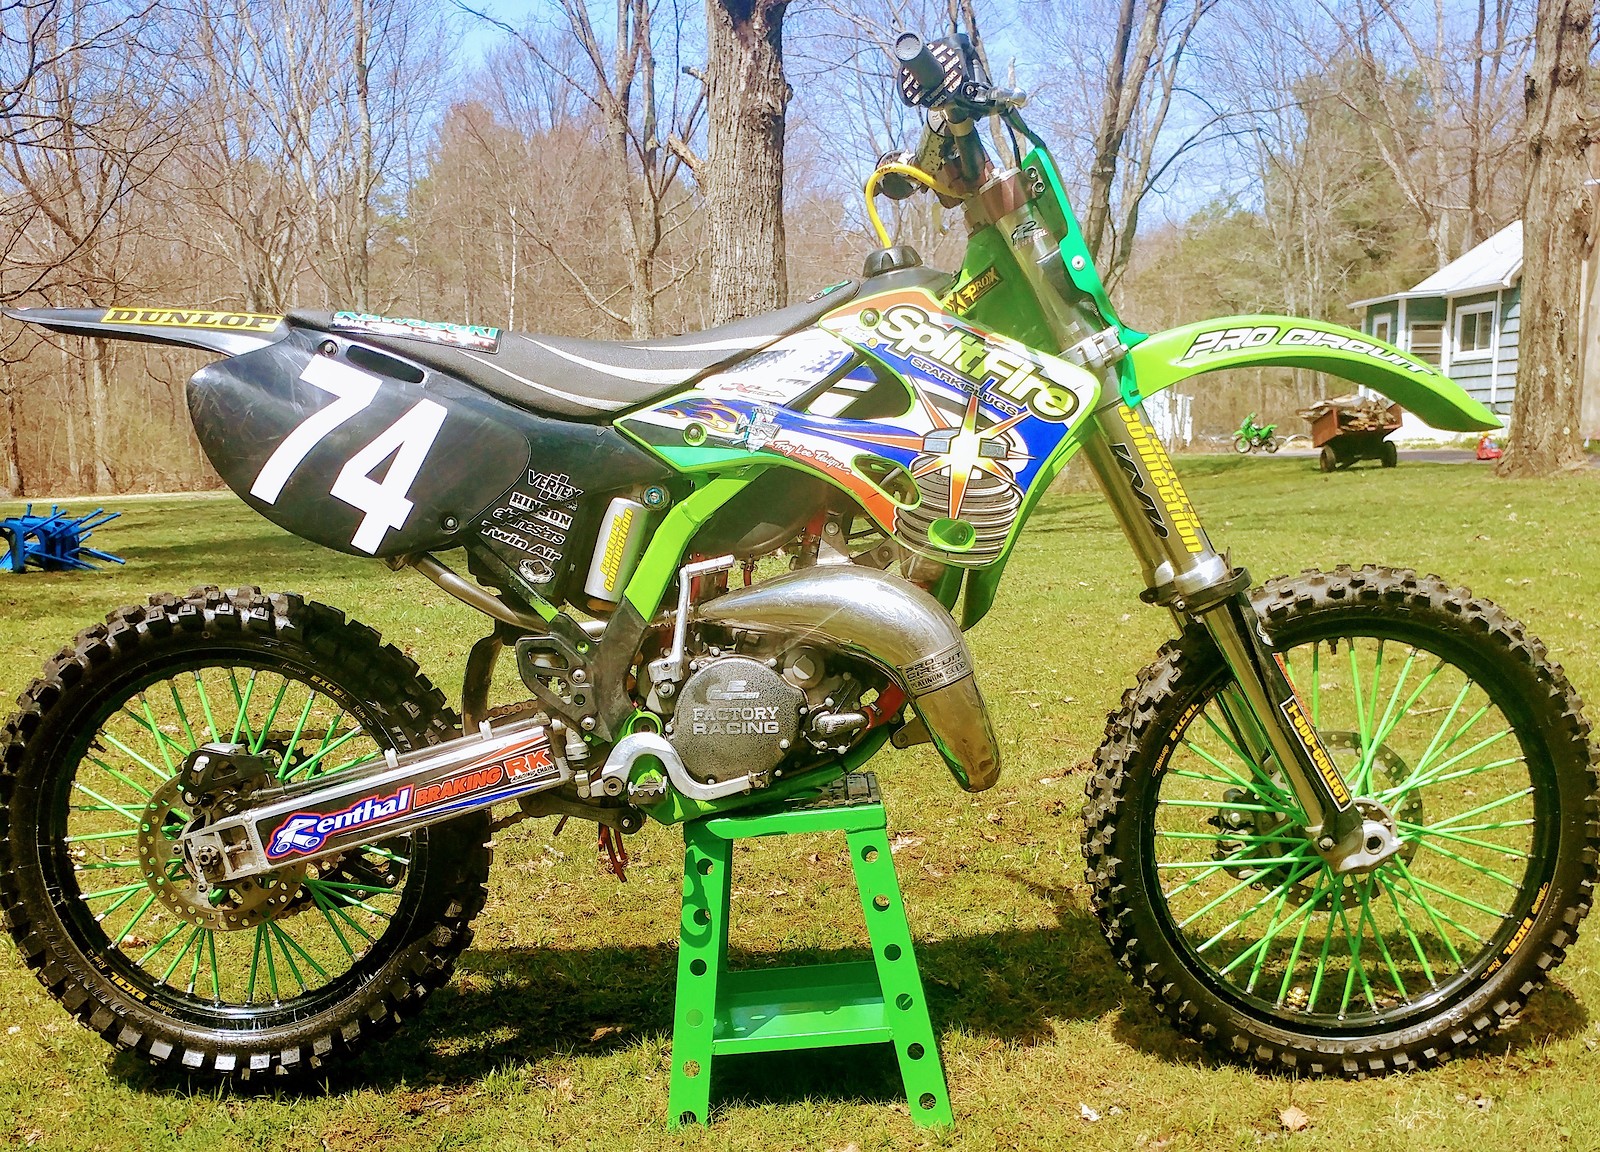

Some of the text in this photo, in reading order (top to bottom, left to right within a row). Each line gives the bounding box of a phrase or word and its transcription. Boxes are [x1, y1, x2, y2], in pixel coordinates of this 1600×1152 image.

[106, 309, 278, 329] DUNLOP
[876, 306, 1077, 420] SplitFire
[1177, 325, 1439, 377] PRO CIRCUIT
[249, 353, 448, 556] 74
[772, 440, 796, 457] Troy
[795, 444, 815, 458] Lee
[527, 468, 585, 500] VERTEX
[508, 491, 574, 531] HINSON
[480, 519, 563, 562] Twin Air
[692, 706, 780, 721] FACTORY
[692, 721, 780, 736] RACING
[1168, 703, 1200, 742] EXCEL
[1286, 701, 1350, 804] 1-800-COLLECT
[270, 749, 552, 855] Renthal BRAKING RK
[1502, 916, 1534, 956] EXCEL
[110, 971, 148, 1001] EXCEL
